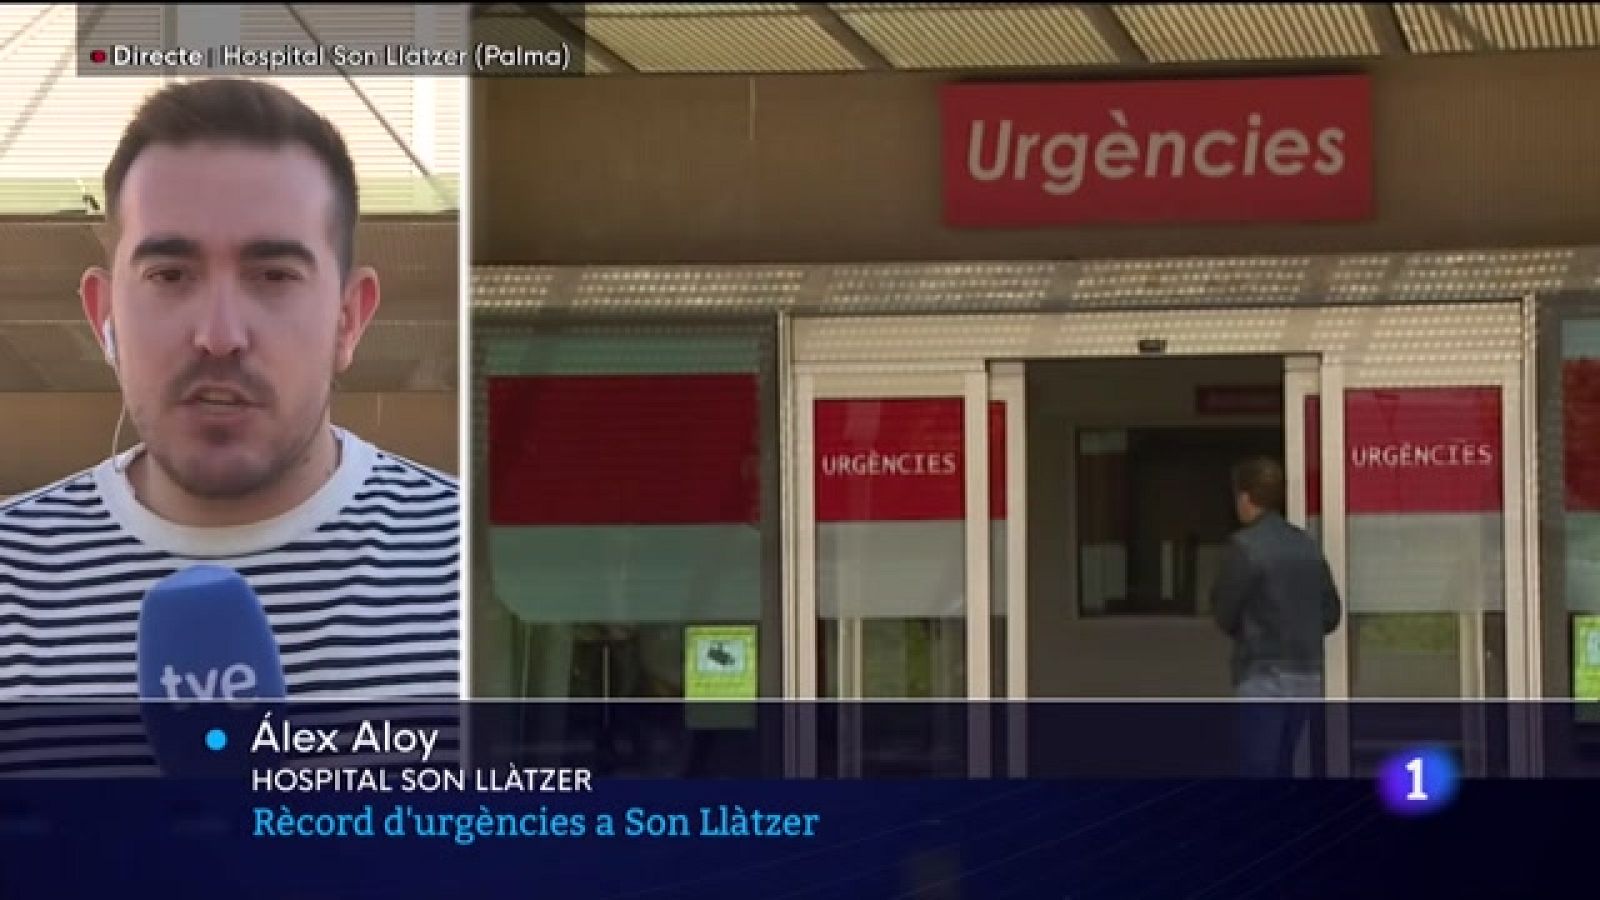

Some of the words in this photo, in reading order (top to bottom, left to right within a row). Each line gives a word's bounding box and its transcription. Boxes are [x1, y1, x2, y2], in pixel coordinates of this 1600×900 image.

[967, 109, 1346, 196] Urgències
[822, 448, 957, 476] URGÈNCIES
[1351, 439, 1493, 467] URGÈNCIES
[160, 662, 257, 706] tve
